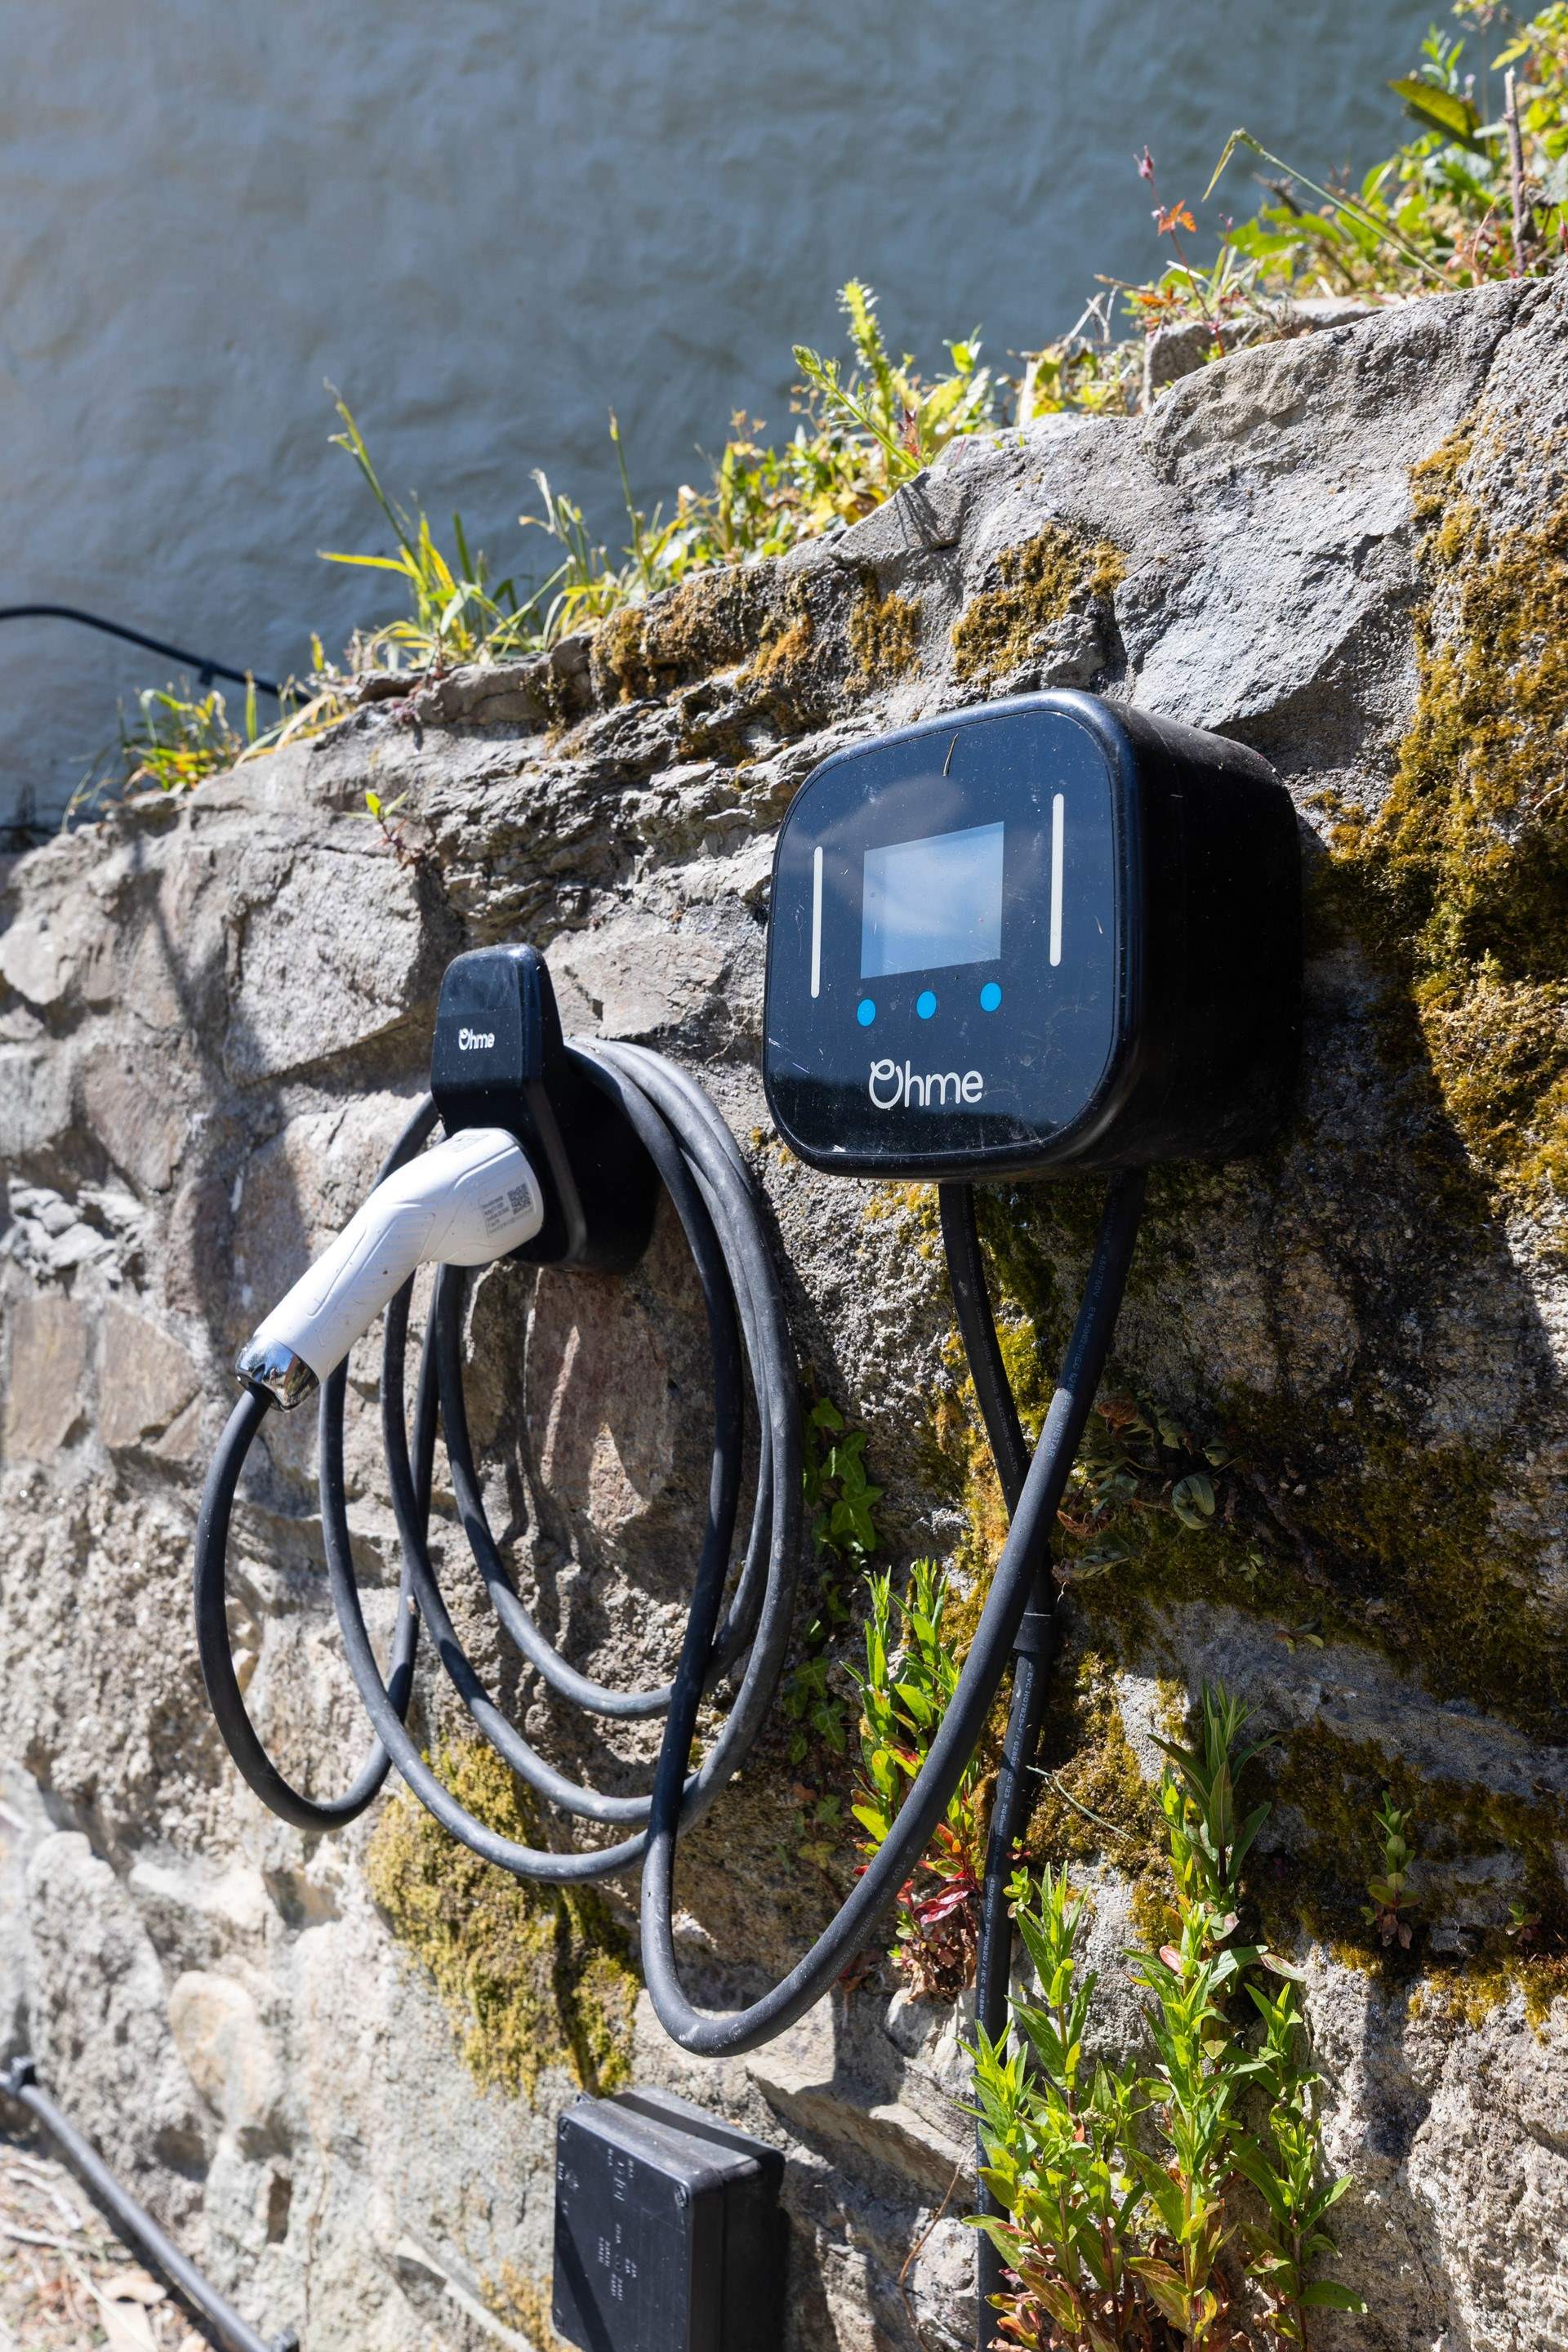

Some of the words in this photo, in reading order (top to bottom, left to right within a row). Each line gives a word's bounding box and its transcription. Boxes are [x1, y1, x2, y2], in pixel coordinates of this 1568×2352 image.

[458, 1027, 495, 1050] Ohme
[868, 1058, 983, 1109] Ohme
[1025, 1673, 1033, 1688] EVC
[986, 1878, 996, 1918] 450/750V
